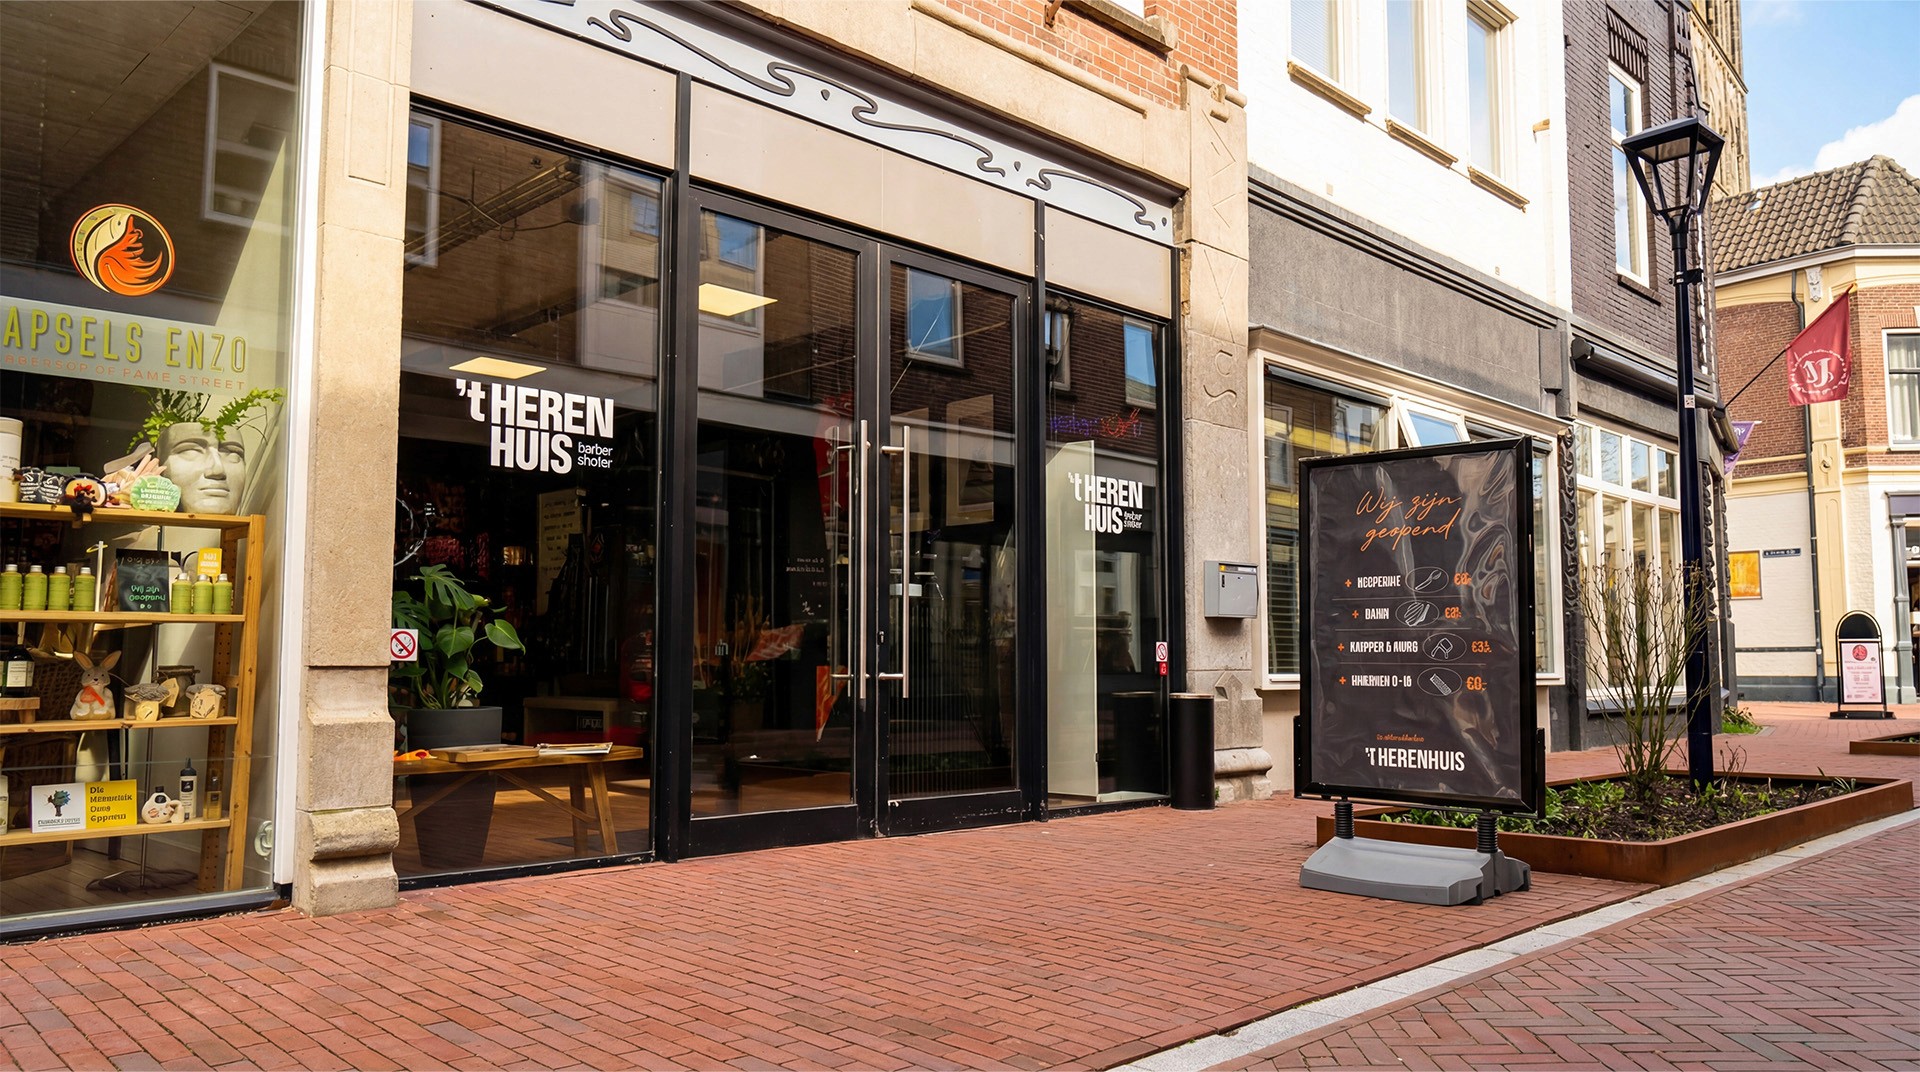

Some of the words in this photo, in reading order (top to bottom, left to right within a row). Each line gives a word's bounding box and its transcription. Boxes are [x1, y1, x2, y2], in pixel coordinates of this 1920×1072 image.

[166, 326, 247, 374] ENZO
[179, 374, 245, 390] STREET
[490, 382, 614, 439] HEREN
[490, 425, 573, 475] HUIS
[578, 441, 613, 457] barber
[1084, 474, 1143, 509] HEREN
[1356, 486, 1403, 524] Wij
[1404, 492, 1462, 521] zijn
[1084, 503, 1123, 534] HUIS
[1360, 507, 1462, 551] geopend
[1378, 747, 1465, 772] HERENHUIS
